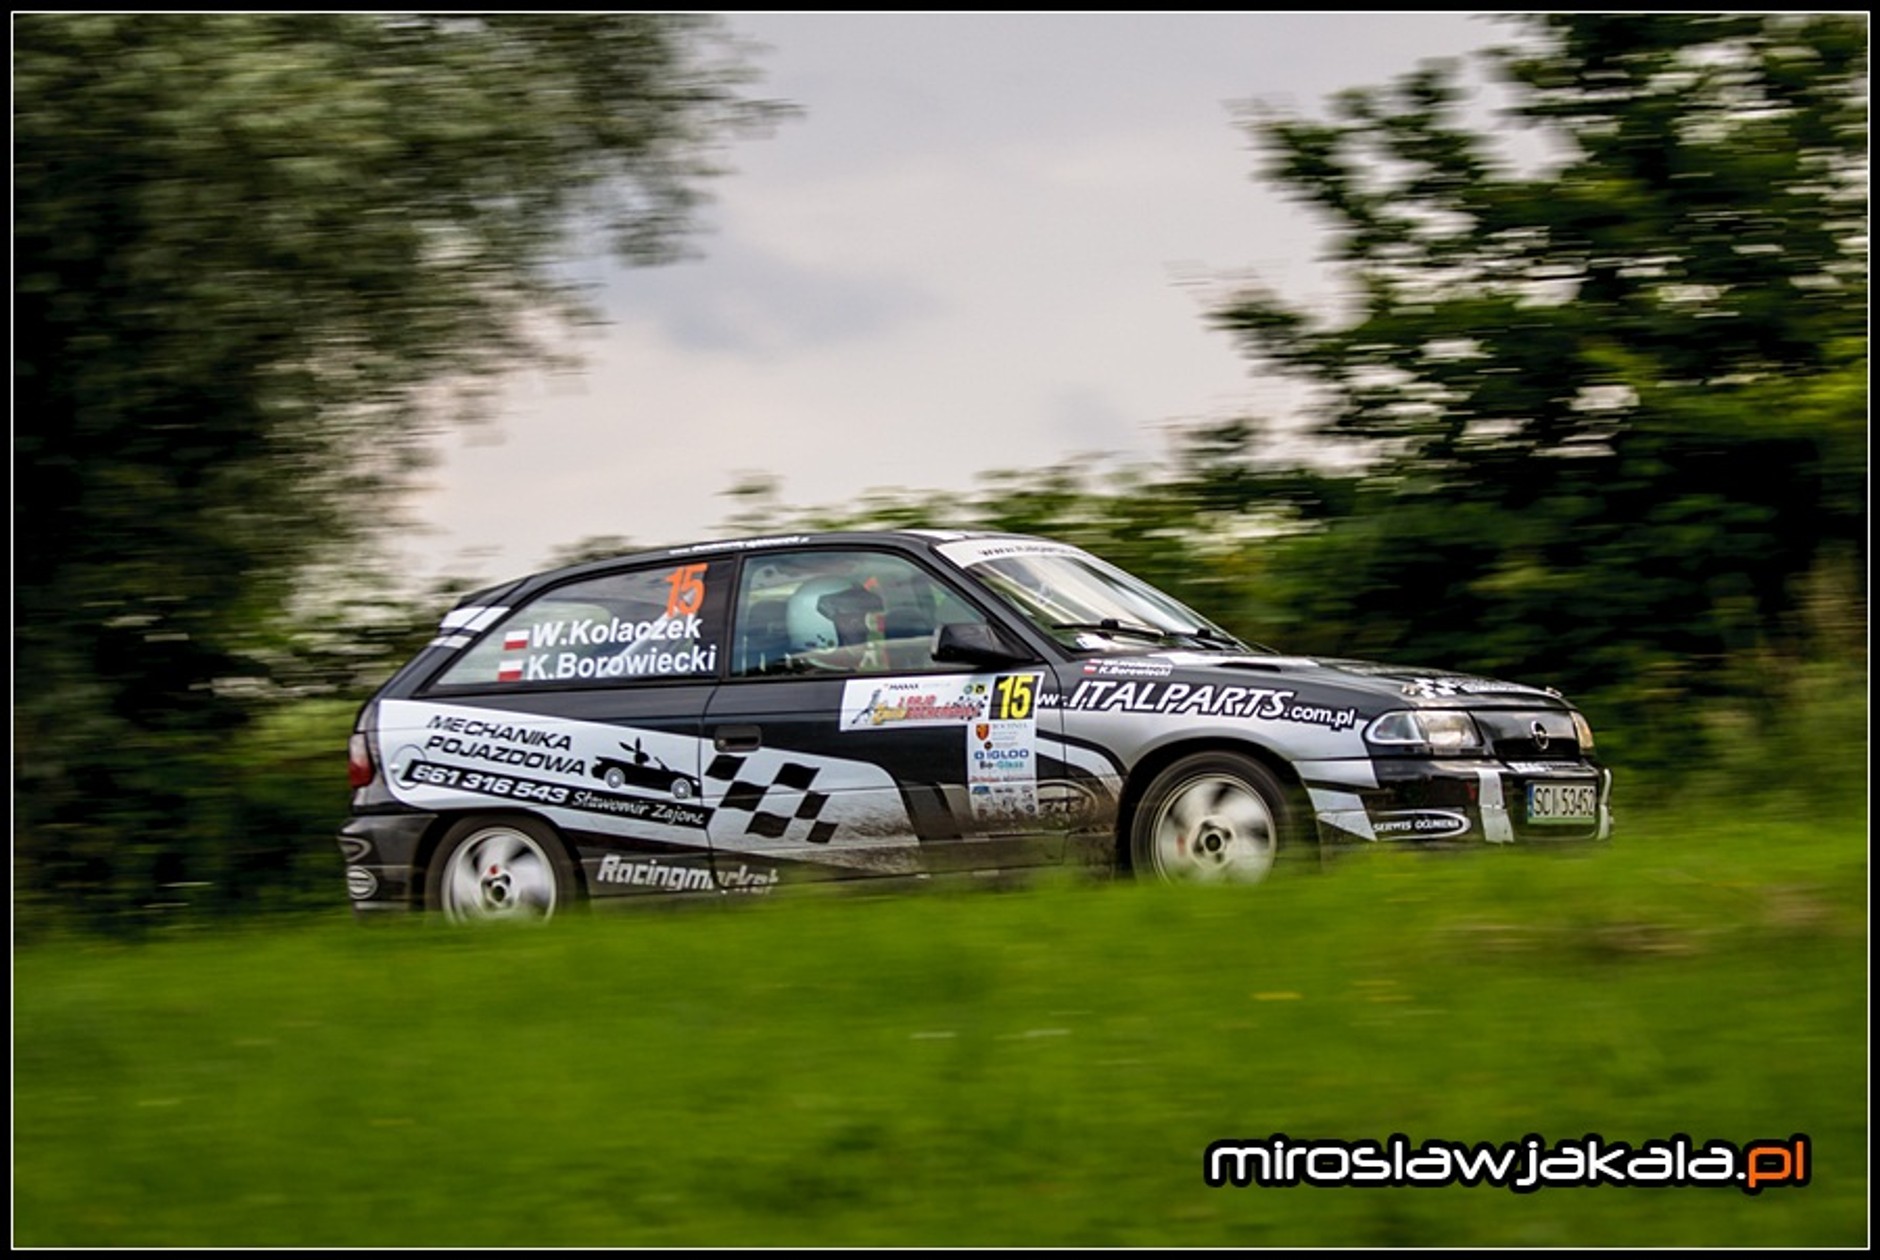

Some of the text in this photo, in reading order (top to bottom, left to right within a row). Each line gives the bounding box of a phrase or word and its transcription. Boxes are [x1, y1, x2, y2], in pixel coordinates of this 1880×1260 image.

[664, 562, 709, 618] 15
[532, 613, 703, 648] W.Kolaczek
[527, 644, 716, 681] K.Borowiecki
[997, 675, 1035, 719] 15
[427, 715, 572, 751] MECHANIKA
[425, 735, 586, 776] POJAZDOWA
[411, 764, 461, 786] 661
[461, 772, 513, 794] 316
[512, 781, 569, 804] 543
